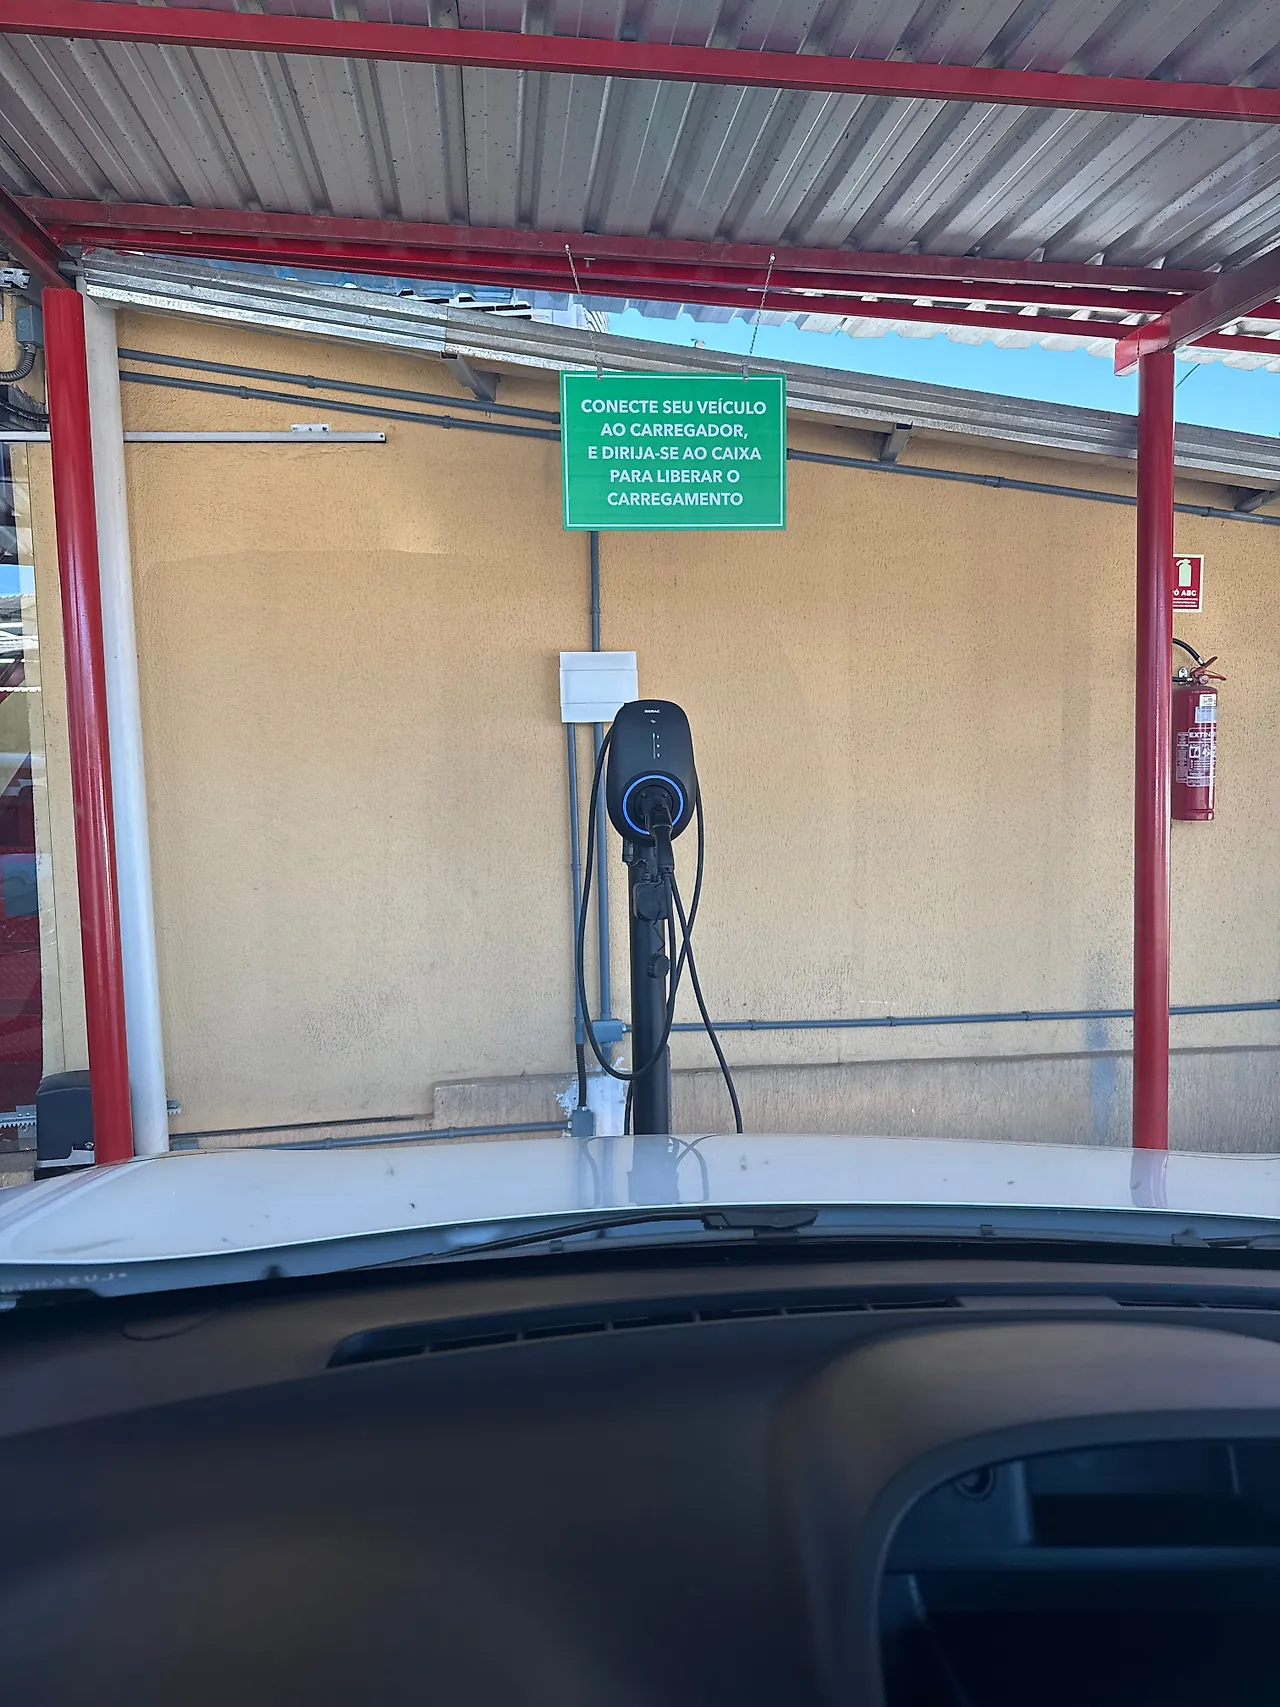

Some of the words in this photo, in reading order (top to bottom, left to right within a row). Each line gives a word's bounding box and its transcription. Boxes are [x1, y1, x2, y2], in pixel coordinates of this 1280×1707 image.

[580, 399, 658, 414] CONECTE
[662, 400, 693, 415] SEU
[697, 398, 767, 415] VEÍCULO
[600, 423, 626, 437] AO
[630, 423, 749, 439] CARREGADOR,
[588, 446, 598, 460] E
[602, 446, 679, 461] DIRIJA-SE
[682, 447, 708, 461] AO
[711, 446, 762, 461] CAIXA
[610, 469, 653, 483] PARA
[657, 469, 723, 484] LIBERAR
[726, 469, 741, 484] O
[607, 492, 744, 507] CARREGAMENTO
[1180, 589, 1197, 597] ABC
